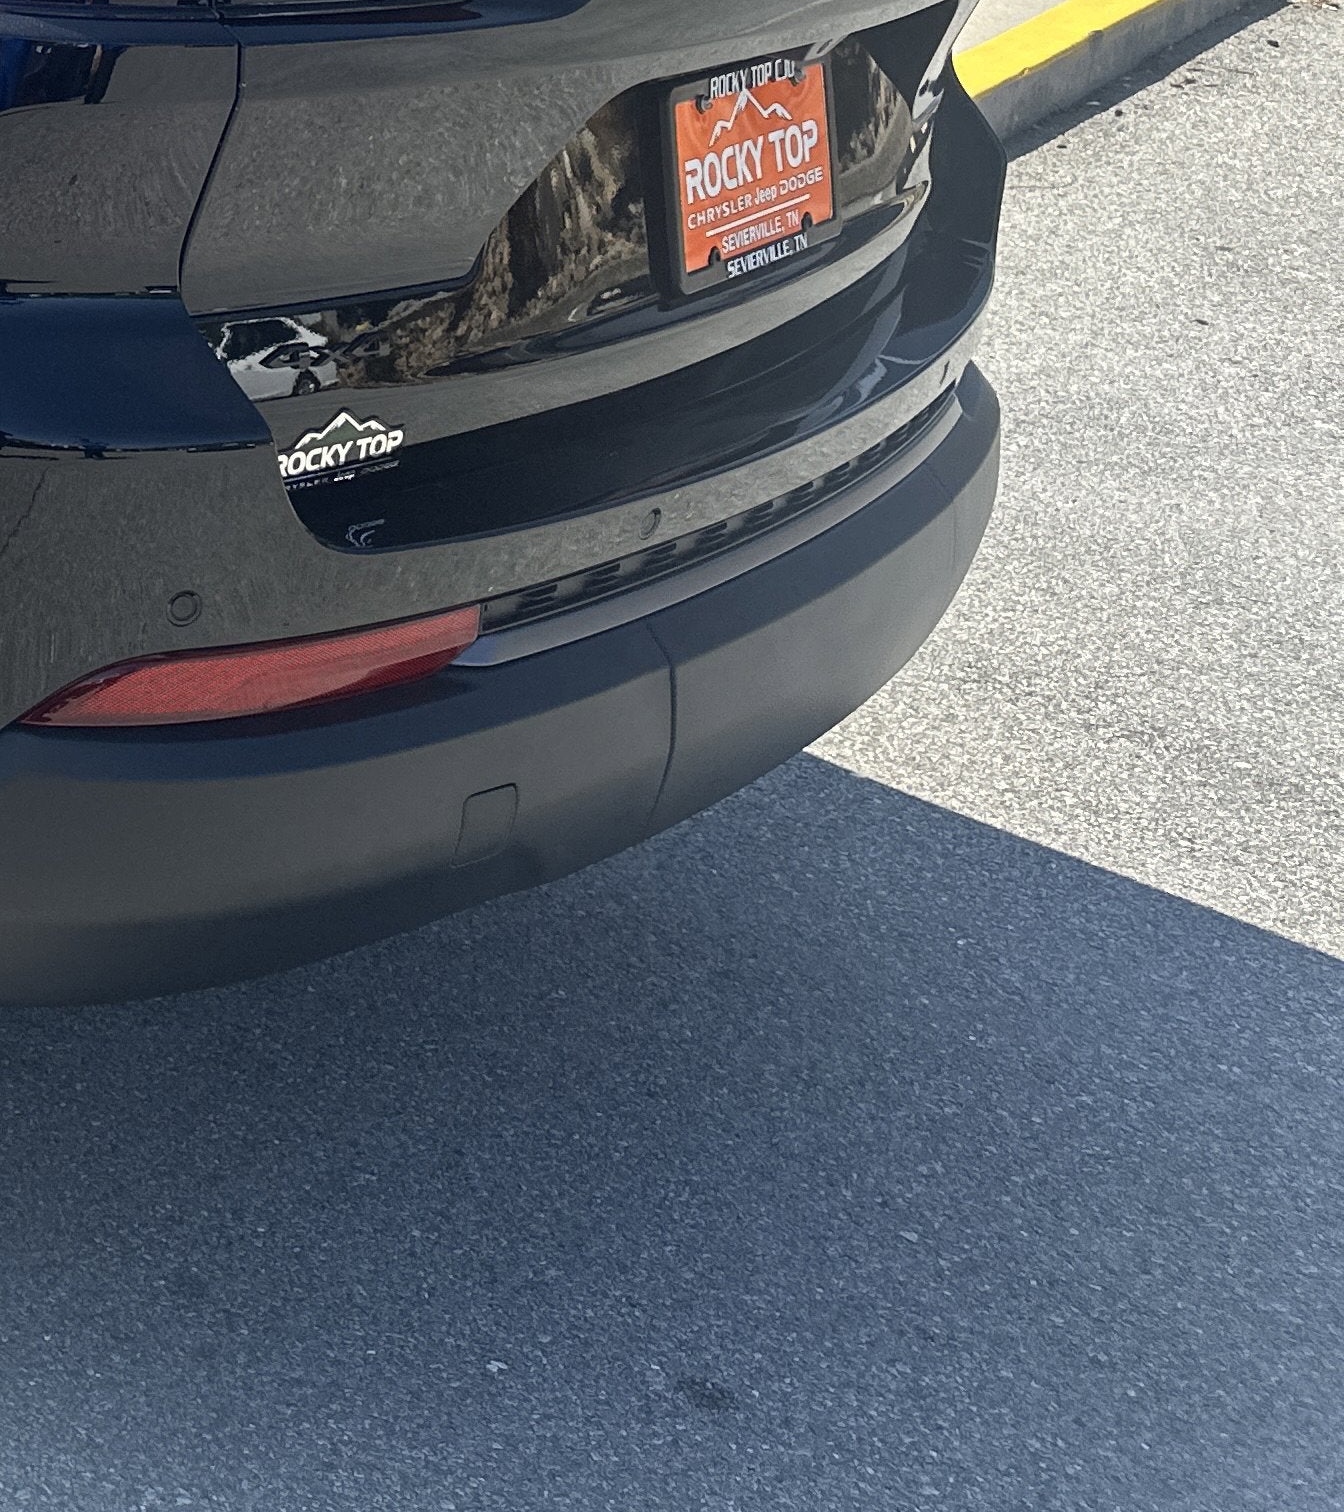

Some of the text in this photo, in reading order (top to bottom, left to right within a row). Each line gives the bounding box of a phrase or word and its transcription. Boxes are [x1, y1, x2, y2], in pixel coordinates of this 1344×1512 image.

[709, 68, 749, 100] ROCKY
[750, 61, 772, 88] TOP
[684, 119, 818, 205] ROCKY TOP
[687, 166, 824, 230] CHRYSLER Jeep DODGE
[721, 209, 800, 253] SEVIERVILLE, TN
[793, 233, 808, 252] TN
[277, 441, 354, 477] ROCKY
[357, 429, 404, 460] TOP
